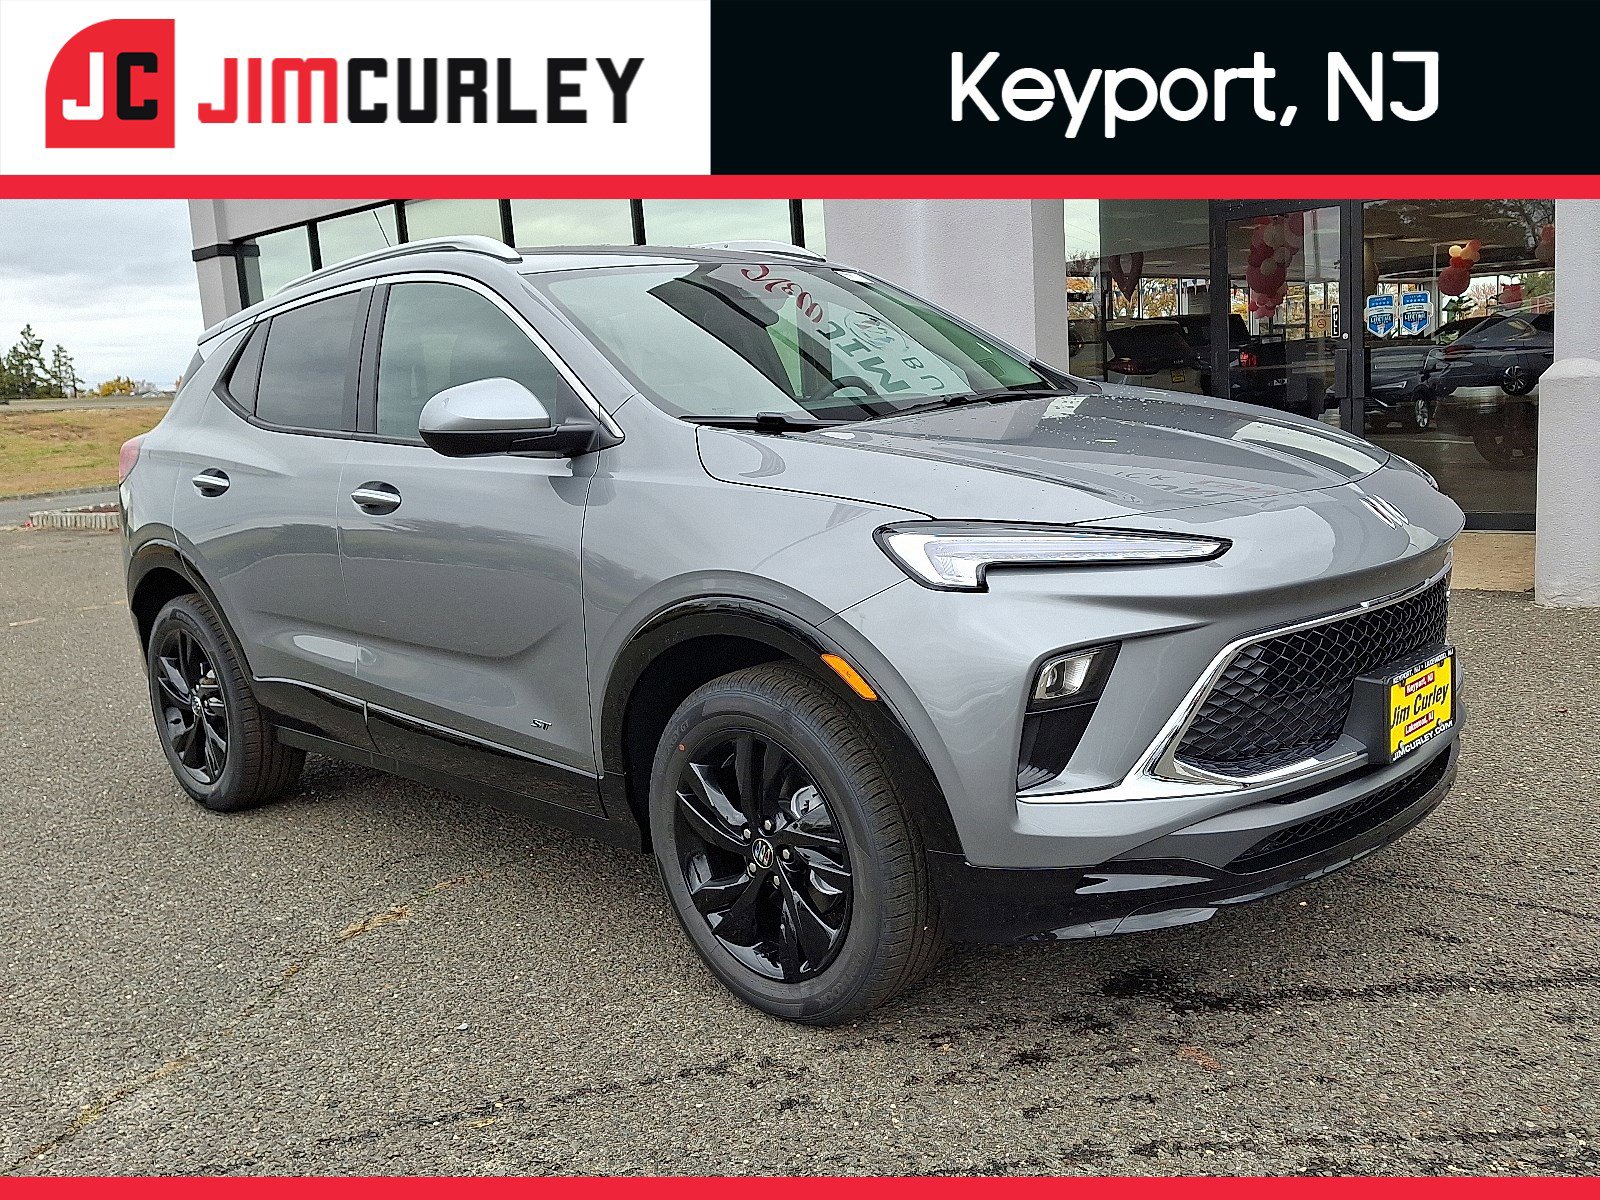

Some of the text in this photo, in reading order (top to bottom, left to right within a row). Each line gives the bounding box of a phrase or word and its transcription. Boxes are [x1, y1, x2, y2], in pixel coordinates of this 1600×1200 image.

[530, 718, 552, 730] ST
[1390, 683, 1449, 729] Jim Curley
[1393, 720, 1453, 762] JIMCURLEY.COM
